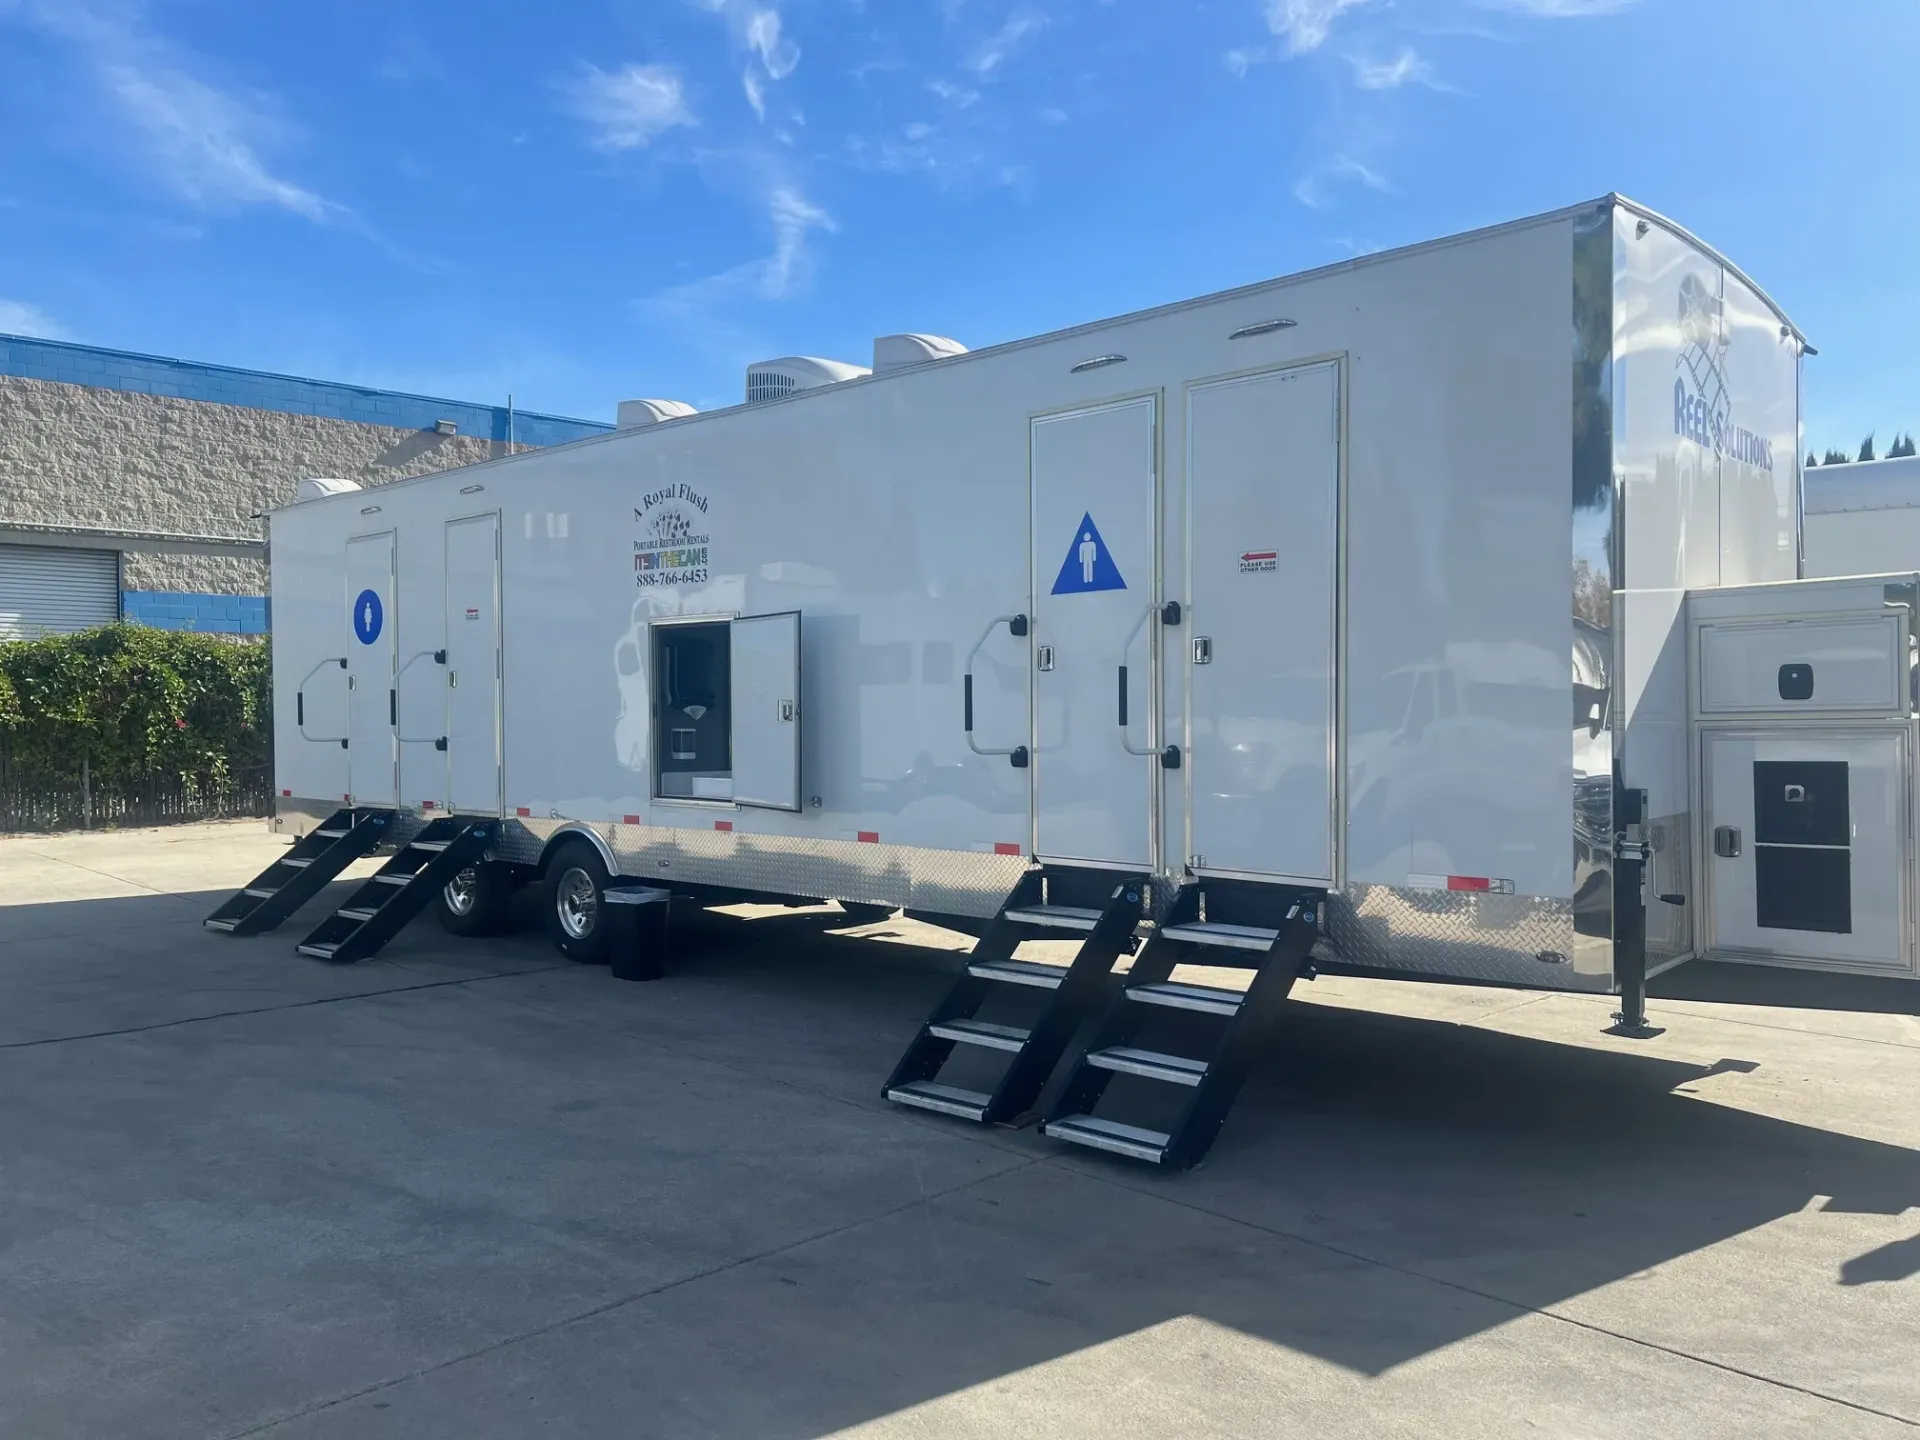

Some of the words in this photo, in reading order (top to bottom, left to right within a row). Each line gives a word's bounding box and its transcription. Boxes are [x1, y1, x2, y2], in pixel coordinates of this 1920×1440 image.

[1674, 376, 1710, 449] REEL
[1715, 410, 1773, 472] SOLUTIONS
[633, 508, 643, 522] A
[643, 484, 675, 510] Royal
[679, 483, 708, 514] Flush
[634, 540, 658, 551] PORTABLE
[659, 537, 686, 548] RESTROOM
[687, 534, 709, 545] RENTALS
[636, 568, 708, 587] 888-766-6453
